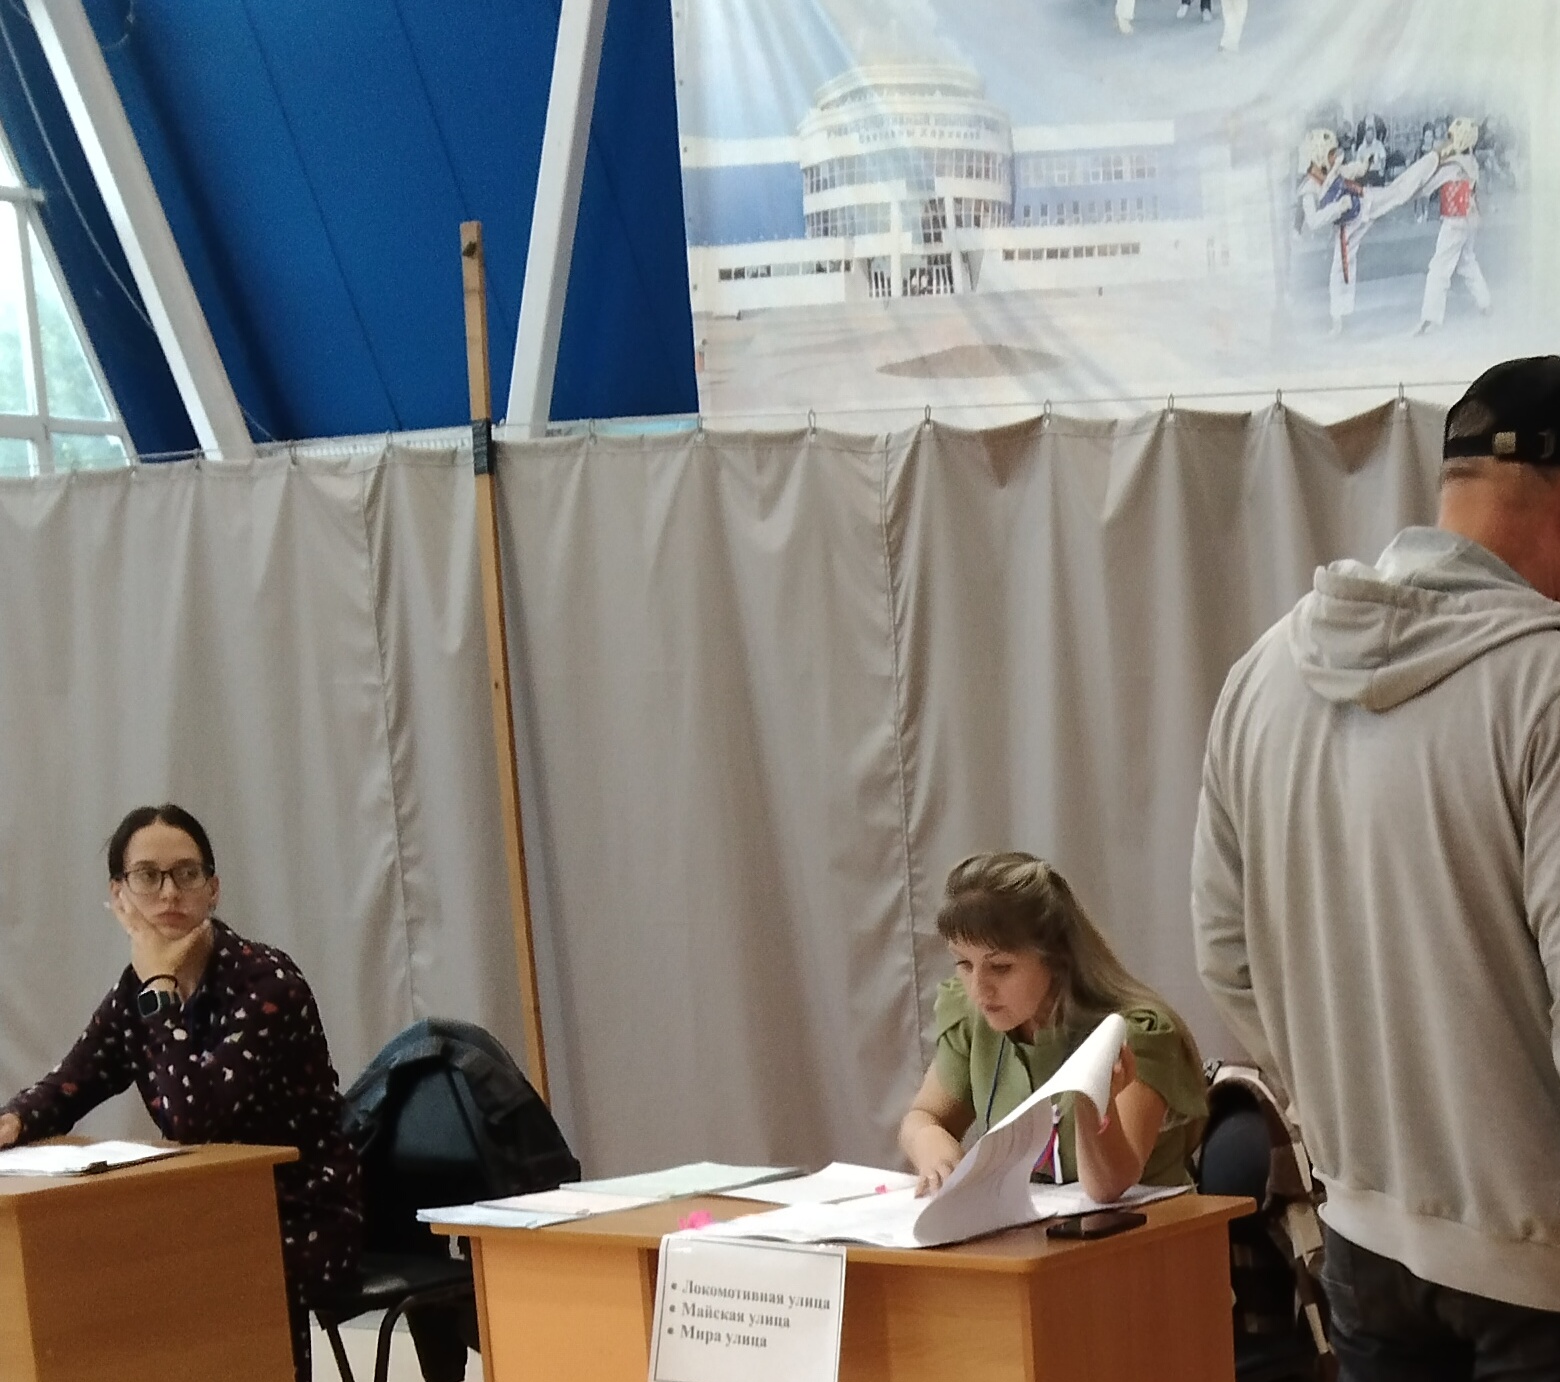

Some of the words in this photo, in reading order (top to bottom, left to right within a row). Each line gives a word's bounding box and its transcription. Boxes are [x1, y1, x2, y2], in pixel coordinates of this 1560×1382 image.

[682, 1280, 784, 1305] Локомотивная
[788, 1295, 831, 1310] улица
[681, 1302, 745, 1323] Майская
[749, 1313, 791, 1329] улица
[680, 1324, 722, 1345] Мира
[726, 1333, 767, 1348] улица
